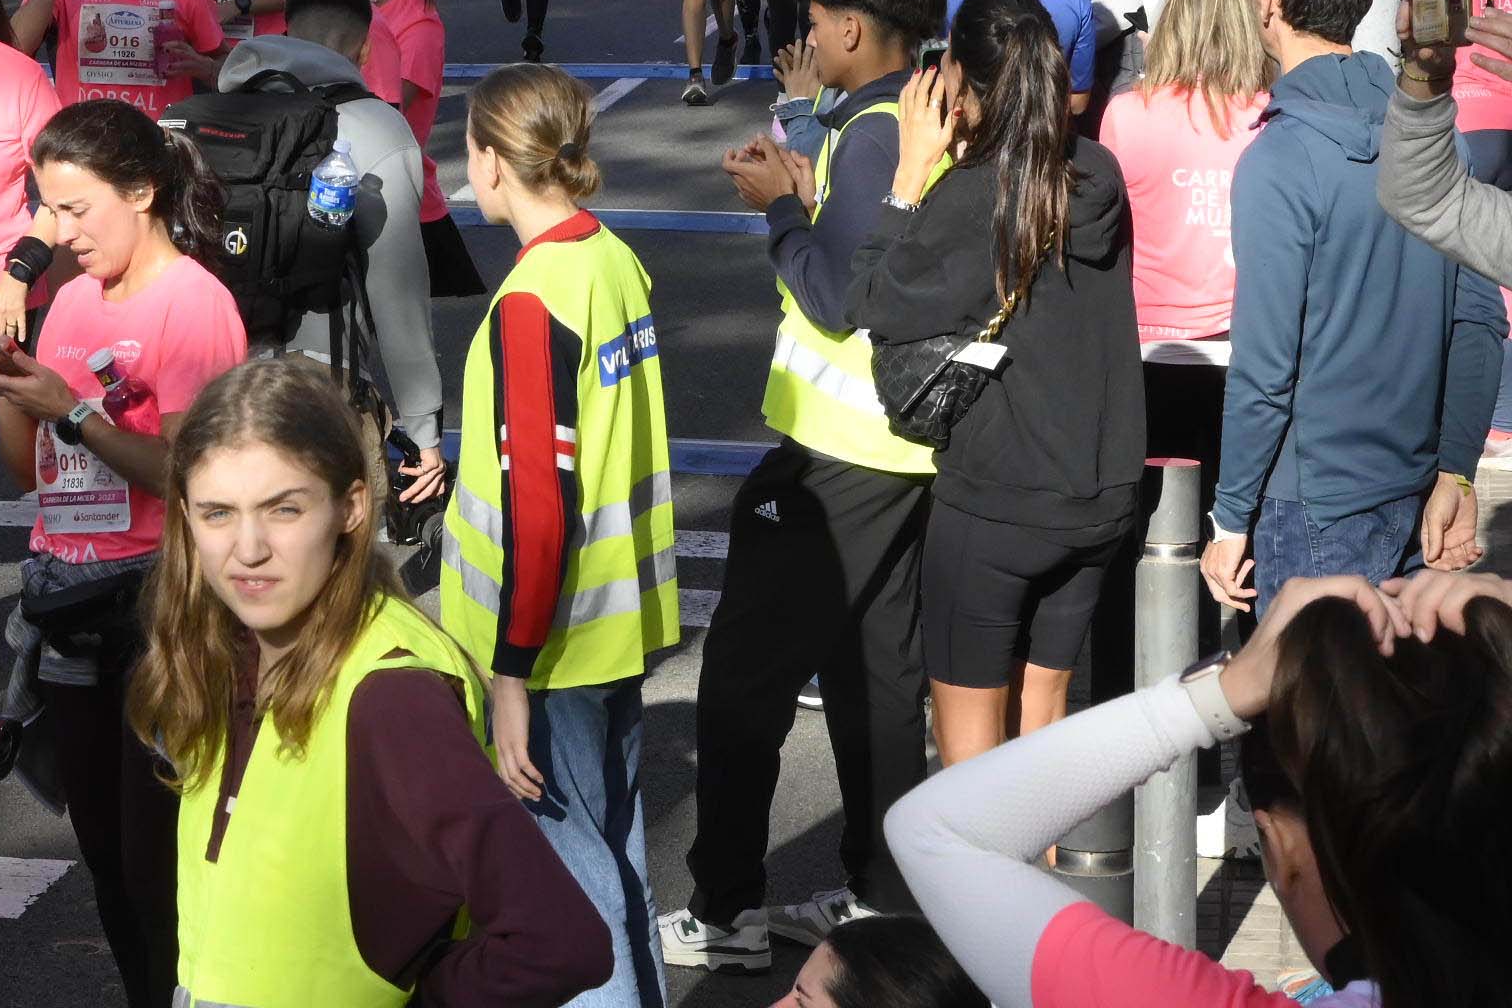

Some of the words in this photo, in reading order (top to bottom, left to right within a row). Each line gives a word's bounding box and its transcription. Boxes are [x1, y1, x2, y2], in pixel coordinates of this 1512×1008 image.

[109, 36, 141, 49] 016
[113, 50, 137, 59] 11926
[1191, 187, 1220, 208] DE
[60, 452, 89, 472] 016
[62, 476, 85, 490] 31836
[79, 511, 121, 522] Santander
[754, 507, 781, 523] adidas
